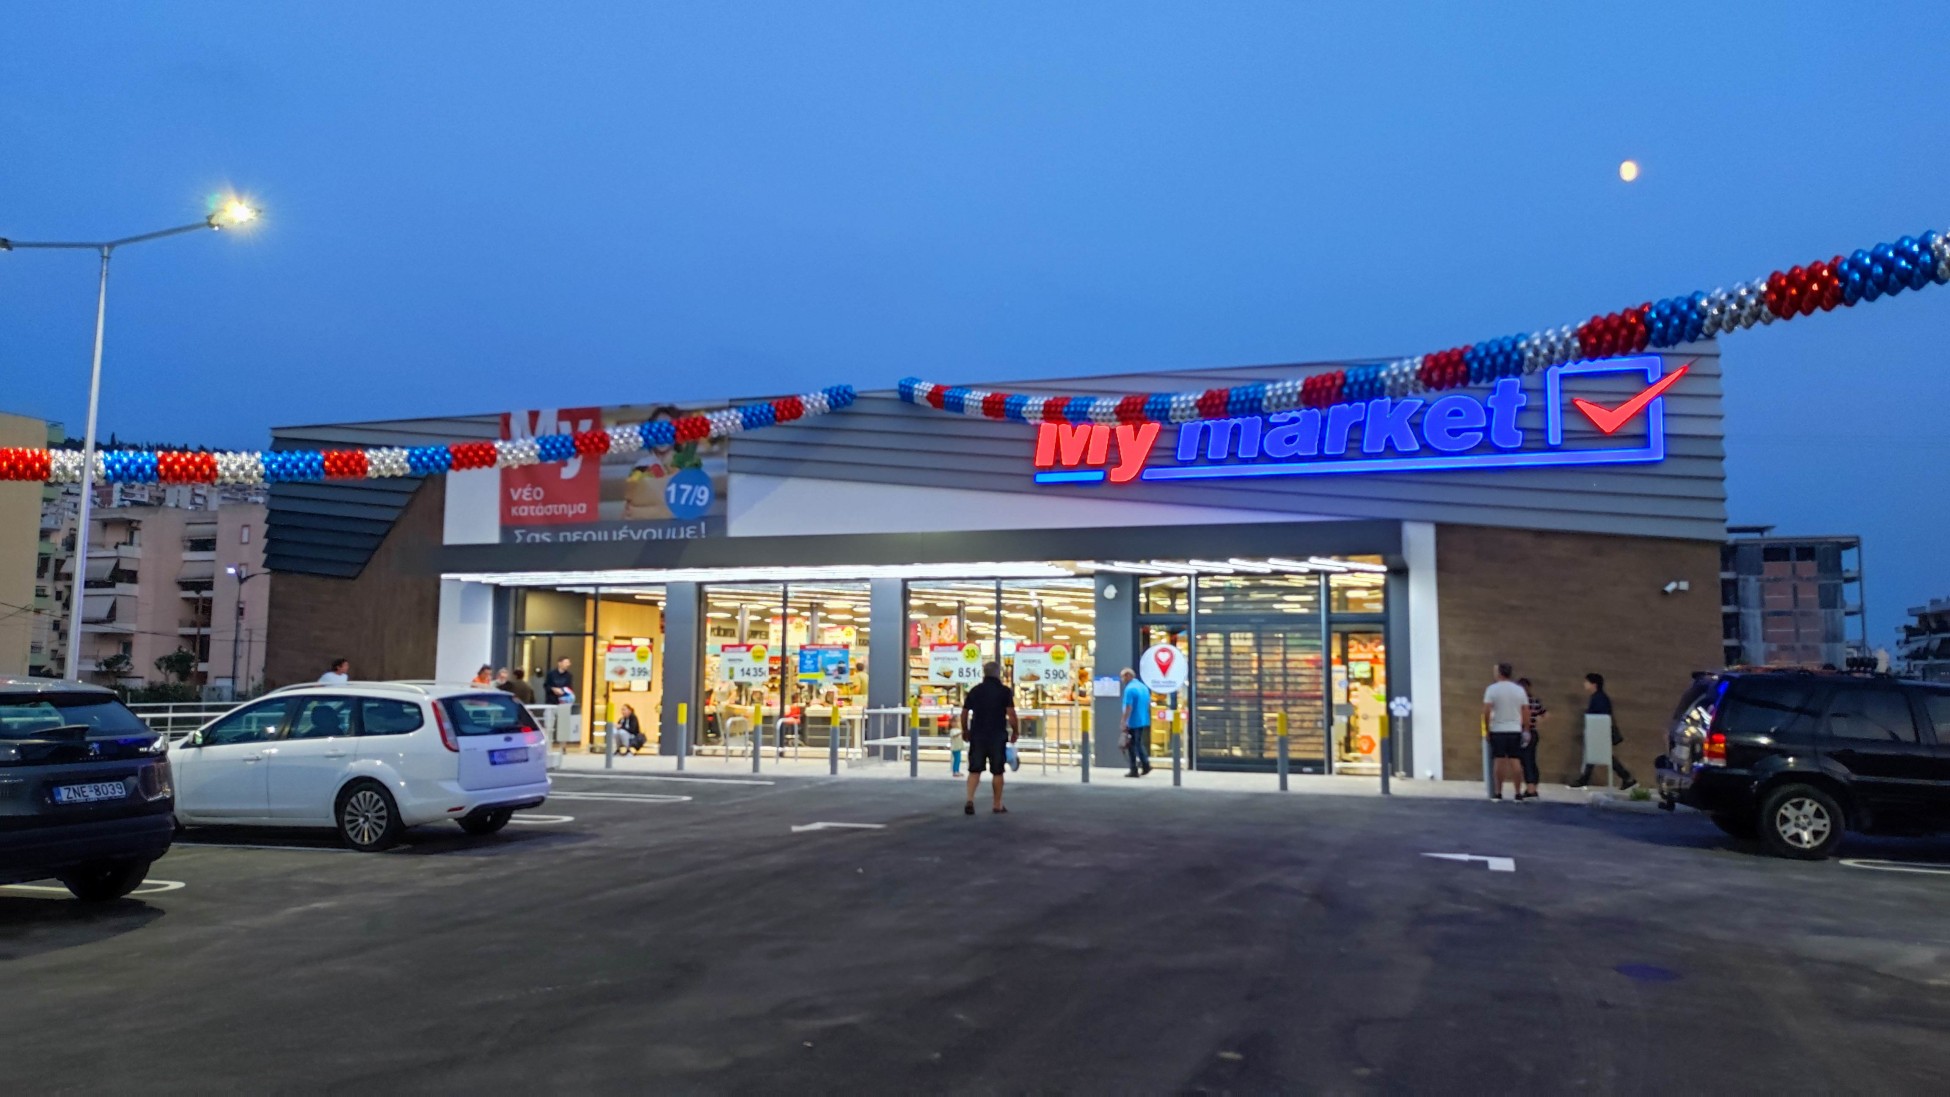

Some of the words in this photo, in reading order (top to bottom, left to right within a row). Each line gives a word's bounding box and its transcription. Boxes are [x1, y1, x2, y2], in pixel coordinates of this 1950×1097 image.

[1035, 421, 1161, 482] My
[1177, 379, 1527, 461] market
[510, 483, 545, 501] νέο
[666, 483, 710, 506] 17/9
[511, 502, 587, 517] κατάστημα
[514, 529, 553, 543] Σας
